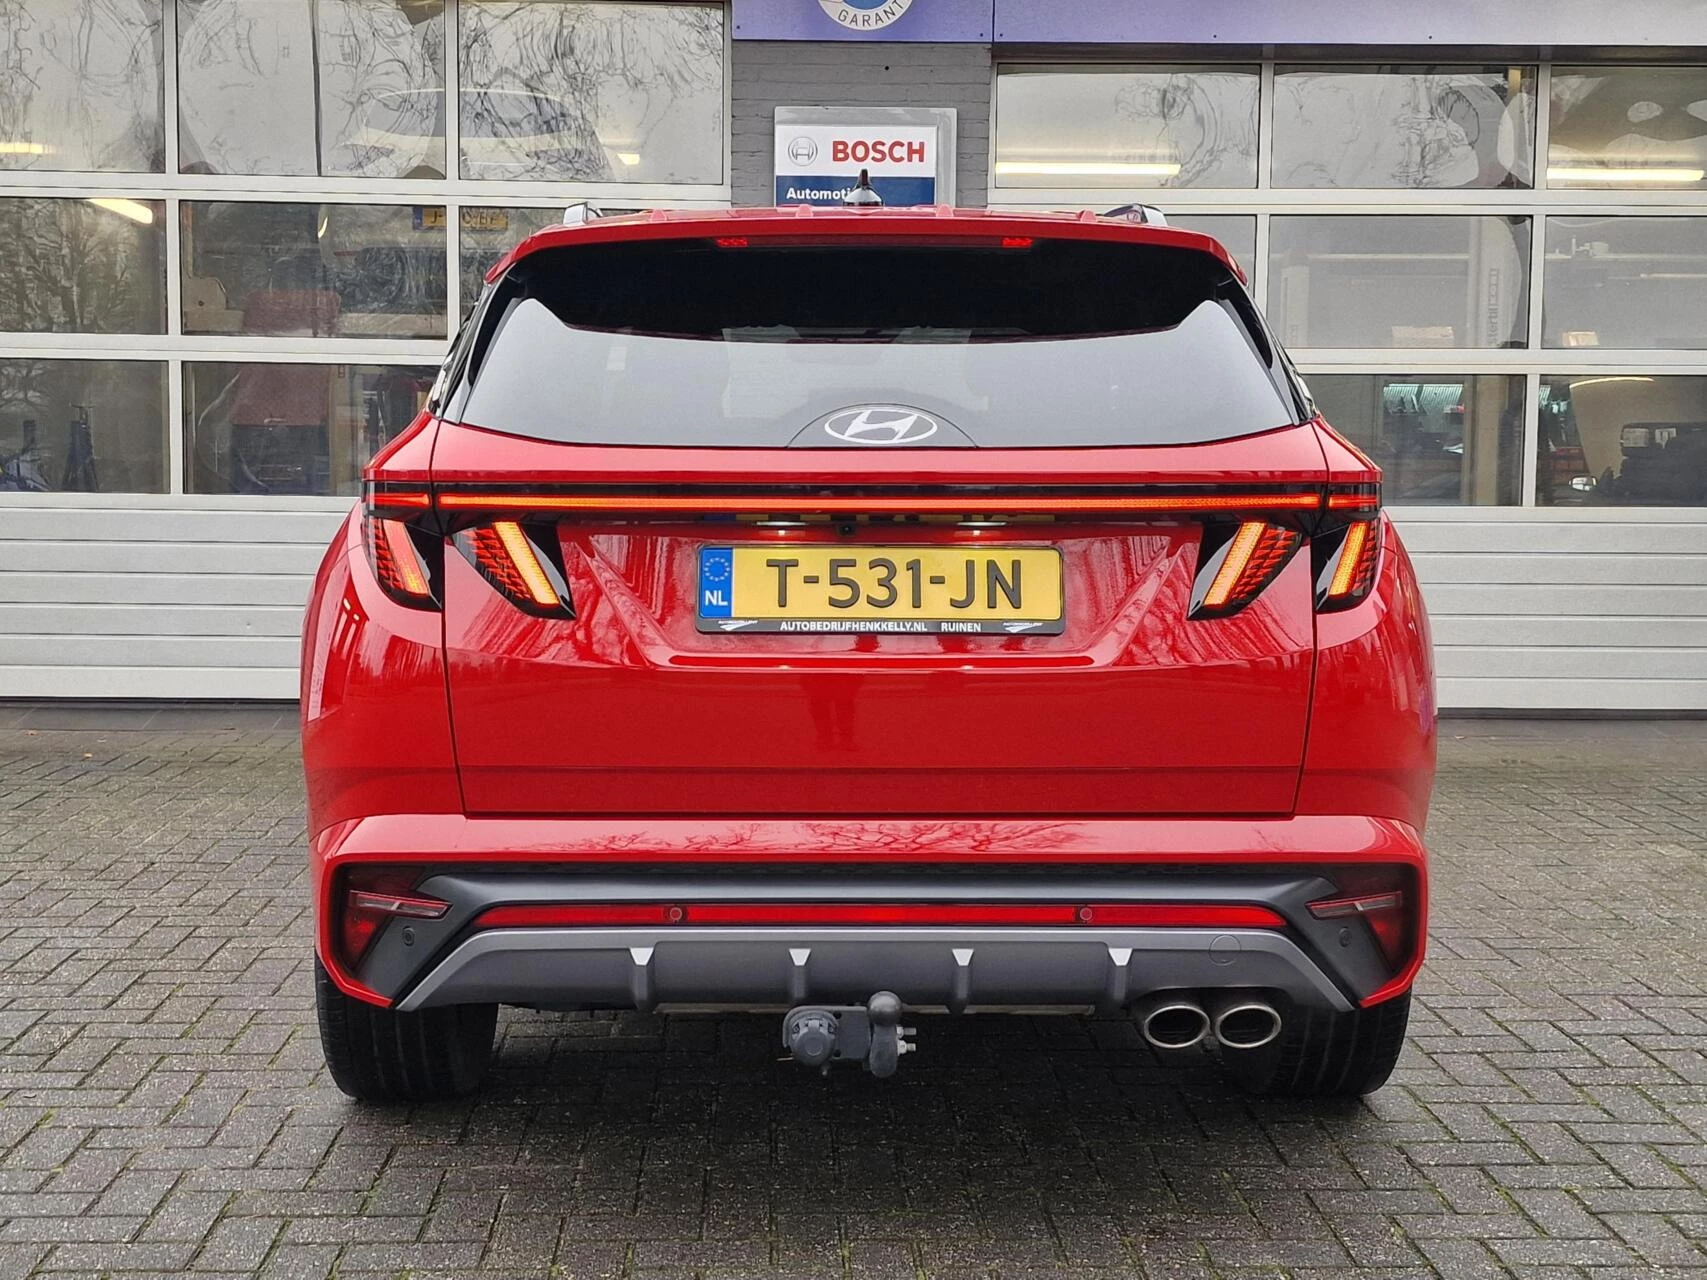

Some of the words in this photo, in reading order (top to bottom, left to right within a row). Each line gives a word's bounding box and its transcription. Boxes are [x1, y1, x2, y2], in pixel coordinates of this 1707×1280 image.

[832, 140, 925, 163] BOSCH
[786, 187, 852, 200] Automoti
[766, 558, 1022, 609] T-531-JN
[705, 590, 728, 606] NL
[780, 621, 927, 632] AUTOBEDRIJFHENKKELLY.NL
[941, 622, 981, 632] RUINEN
